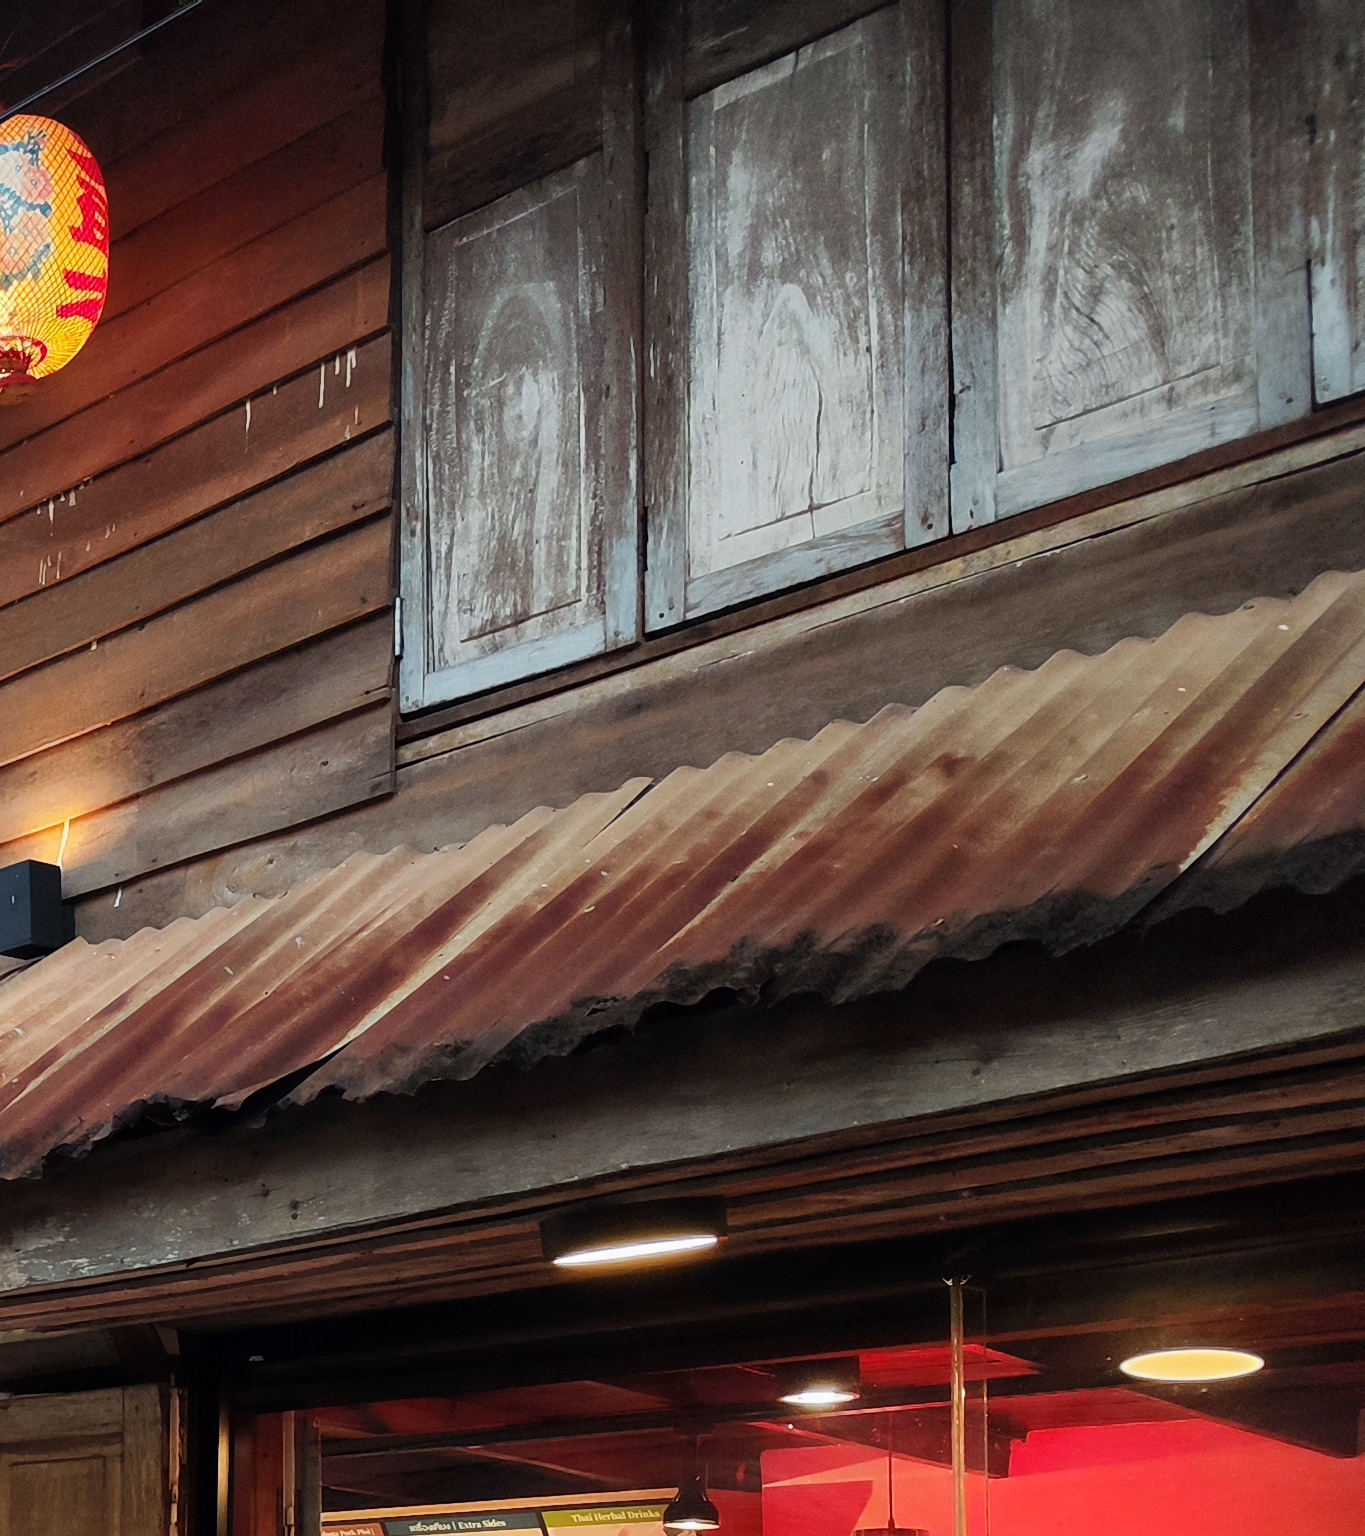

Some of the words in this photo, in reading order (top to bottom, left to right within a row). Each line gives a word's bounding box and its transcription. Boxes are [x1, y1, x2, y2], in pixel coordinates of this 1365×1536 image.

[571, 1513, 593, 1523] Thai
[595, 1511, 626, 1522] Herbal
[628, 1509, 661, 1520] Drinks
[458, 1521, 482, 1530] Extra
[482, 1518, 507, 1528] Sides
